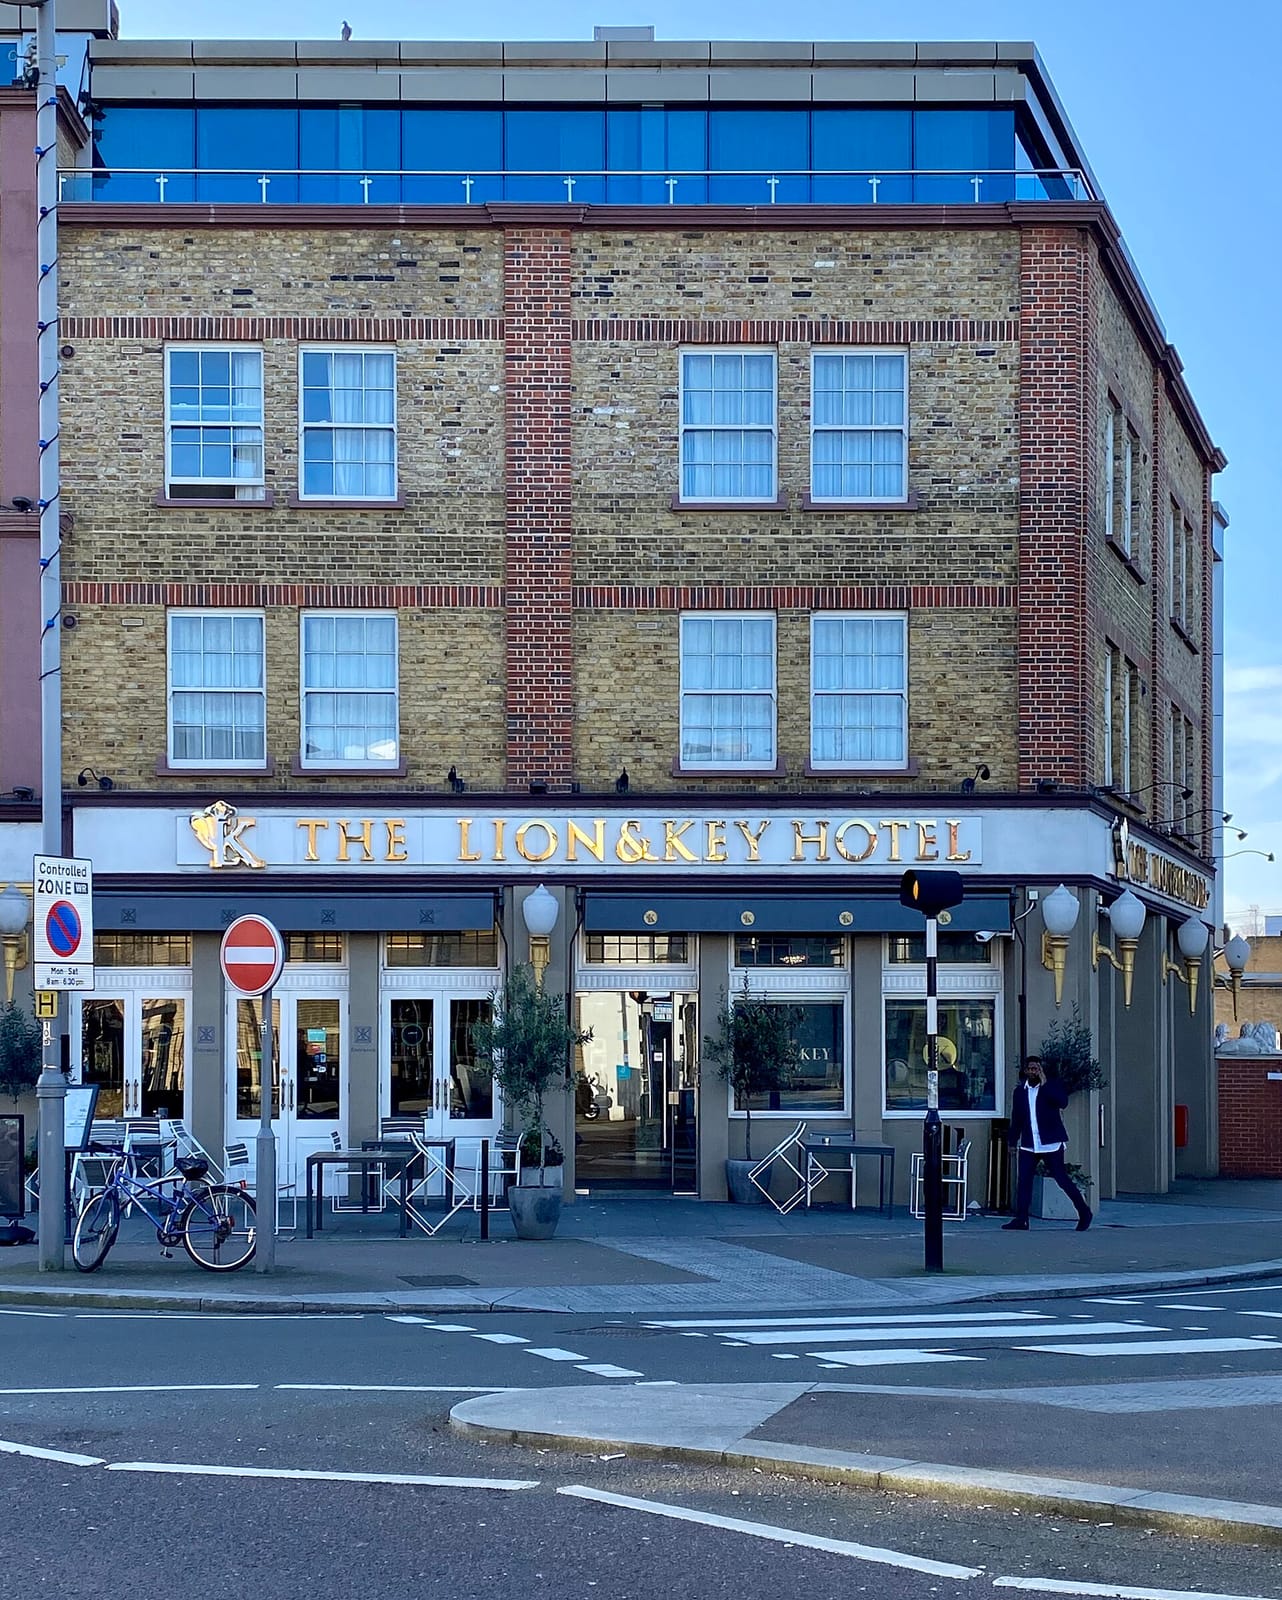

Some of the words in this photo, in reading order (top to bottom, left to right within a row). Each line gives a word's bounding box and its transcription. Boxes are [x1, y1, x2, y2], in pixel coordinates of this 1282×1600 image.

[297, 819, 408, 862] THE
[790, 819, 972, 862] HOTEL
[39, 862, 87, 877] Controlled
[37, 879, 72, 895] ZONE
[39, 994, 54, 1015] H
[800, 1047, 832, 1060] KEY
